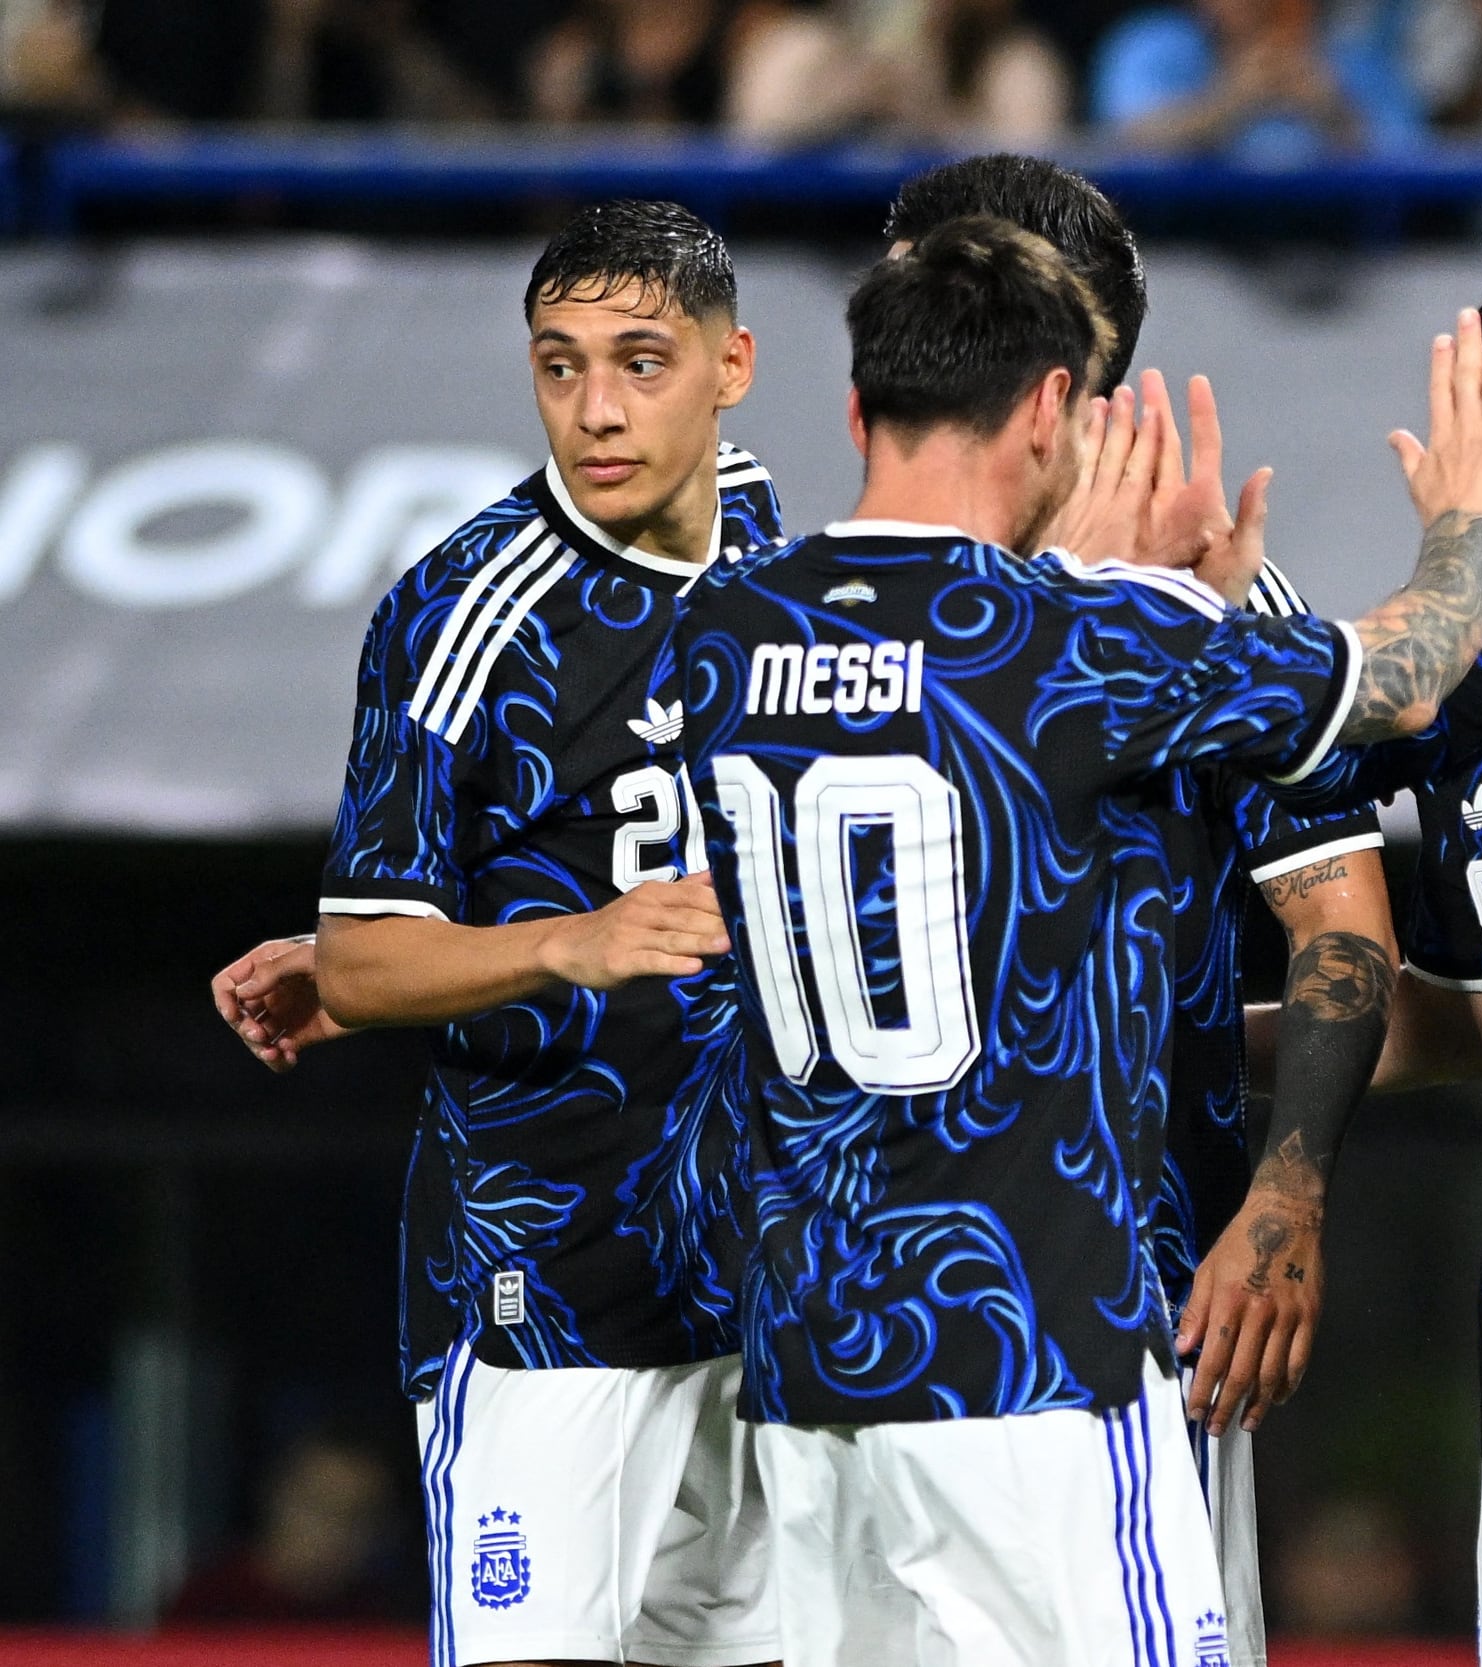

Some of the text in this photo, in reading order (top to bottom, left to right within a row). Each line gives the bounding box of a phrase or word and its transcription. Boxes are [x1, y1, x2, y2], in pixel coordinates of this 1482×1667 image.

[746, 640, 924, 715] MESSI
[610, 762, 711, 893] 2
[712, 754, 981, 1096] 10
[481, 1551, 518, 1587] AFA
